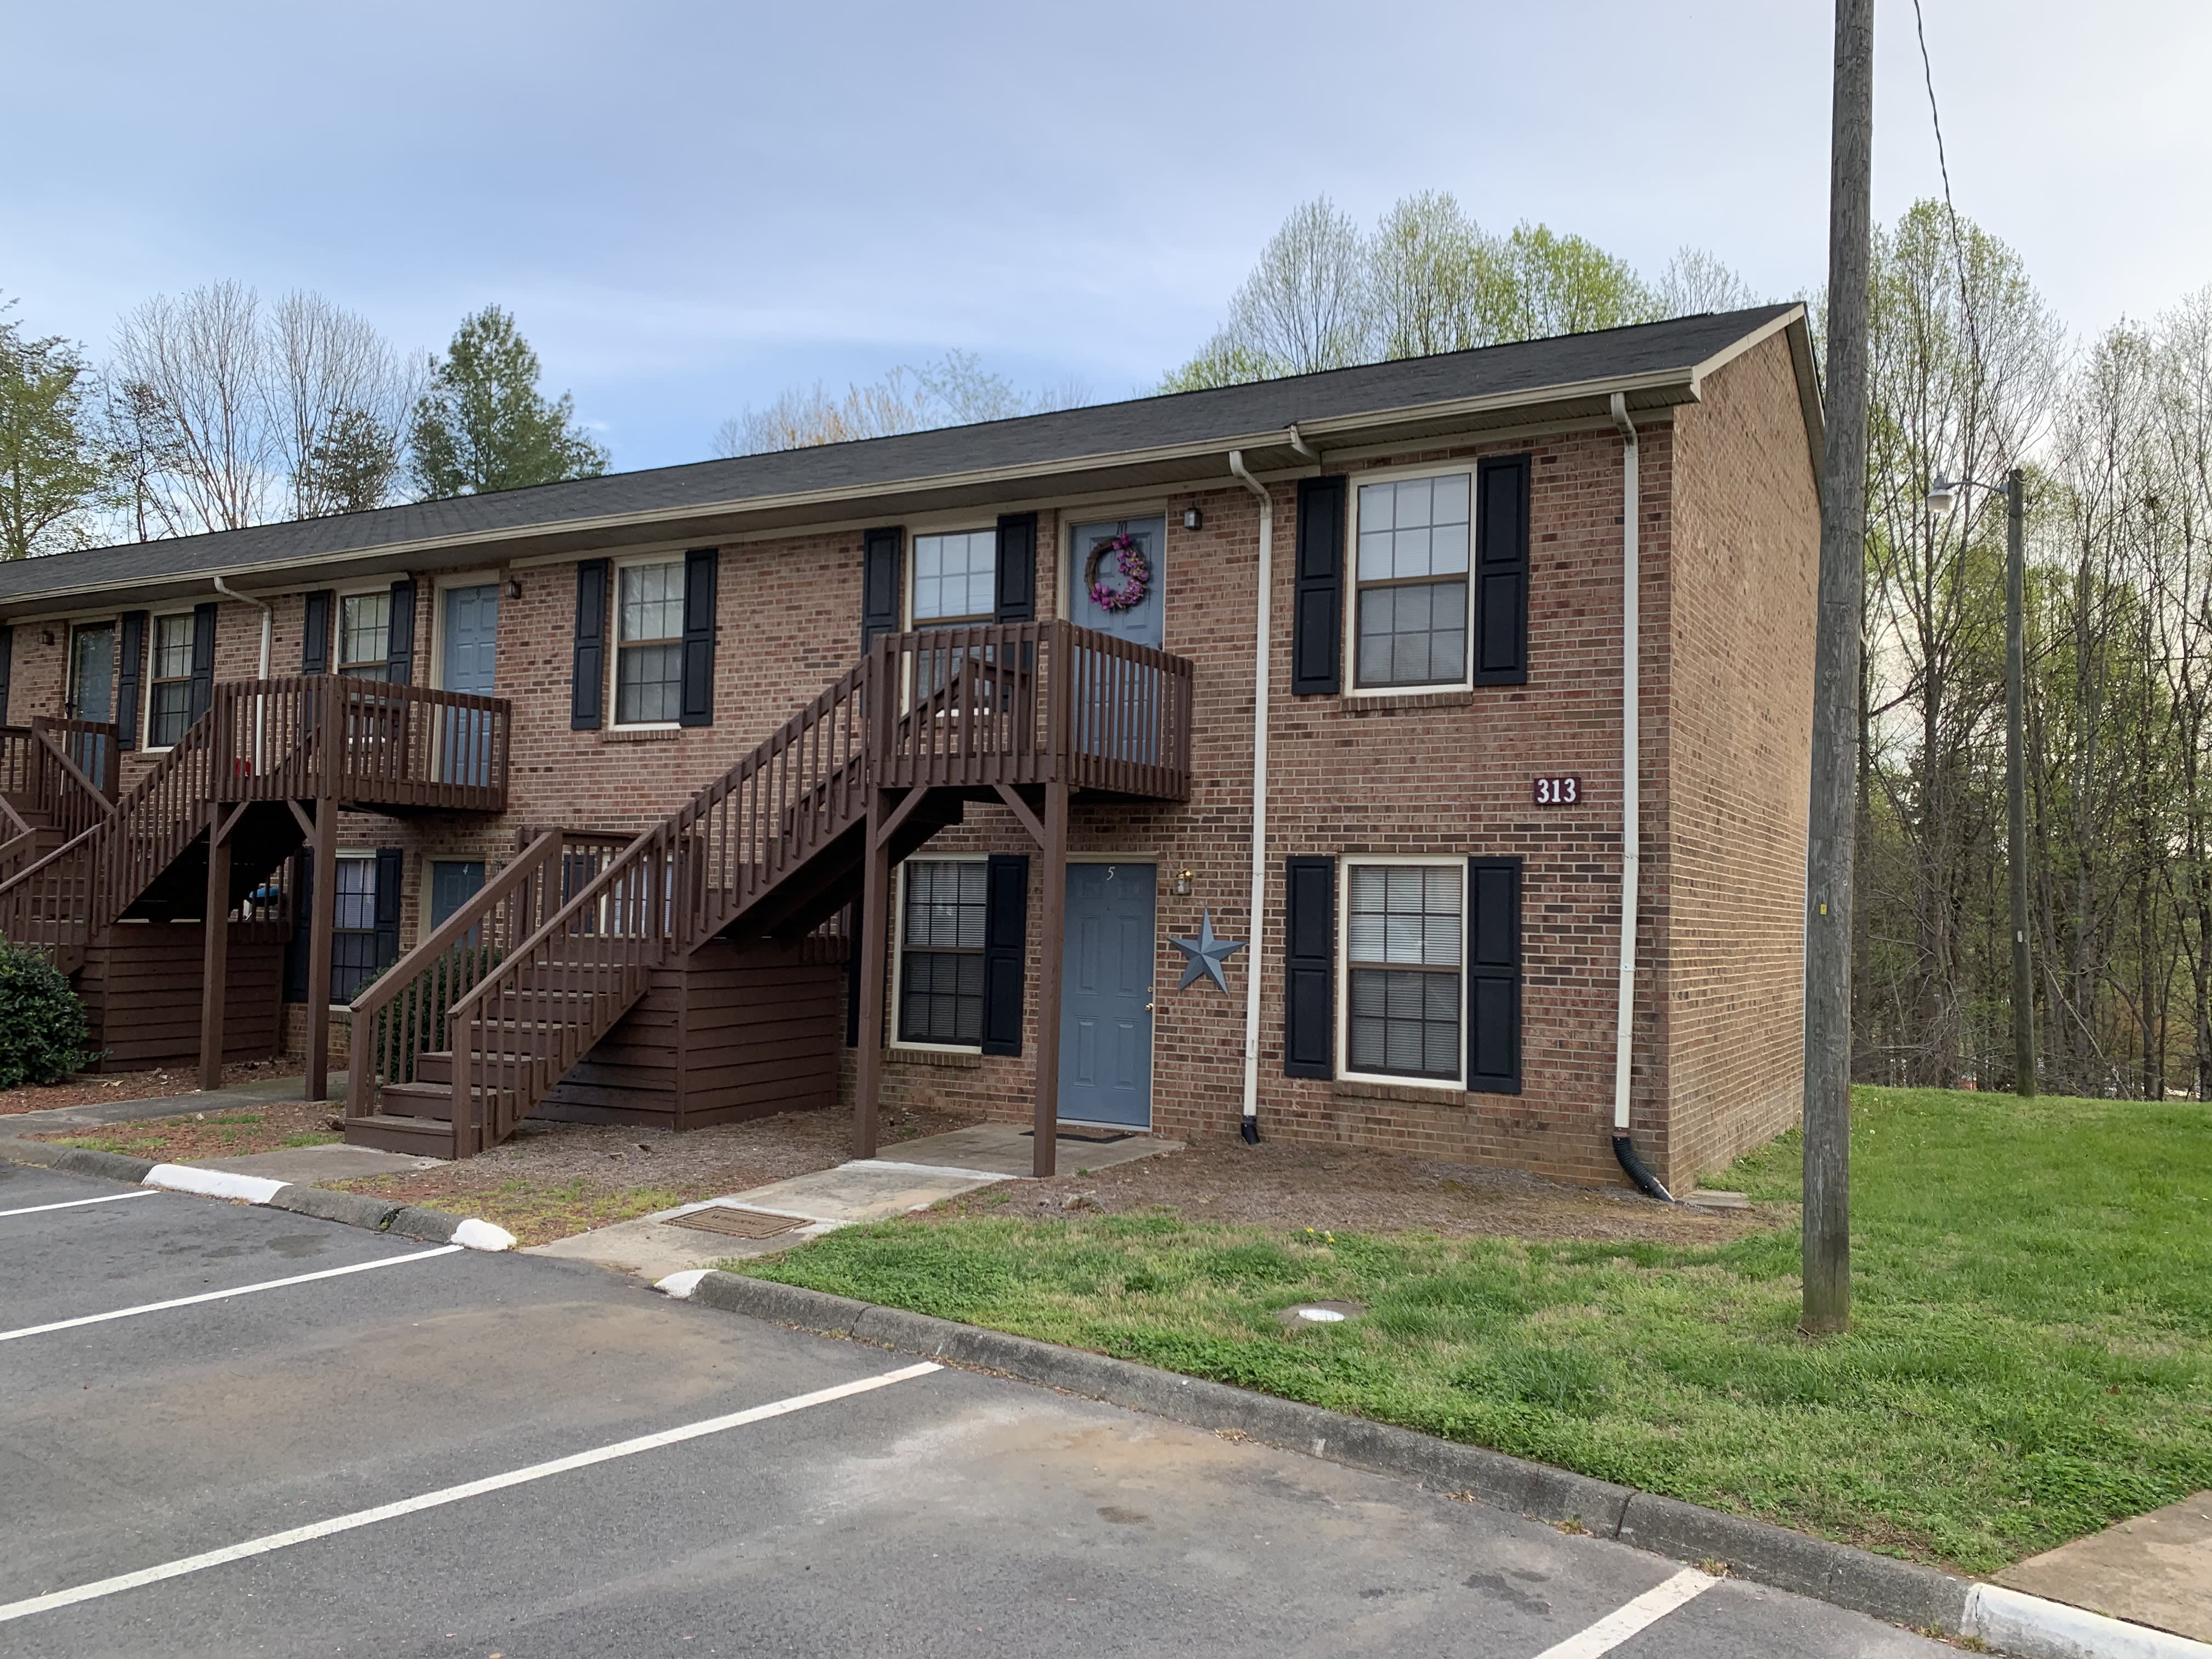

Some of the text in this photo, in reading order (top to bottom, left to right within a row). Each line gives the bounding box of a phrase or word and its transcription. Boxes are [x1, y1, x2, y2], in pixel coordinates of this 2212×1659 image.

[1537, 778, 1576, 803] 313
[462, 864, 469, 876] 4
[1107, 866, 1115, 881] 5
